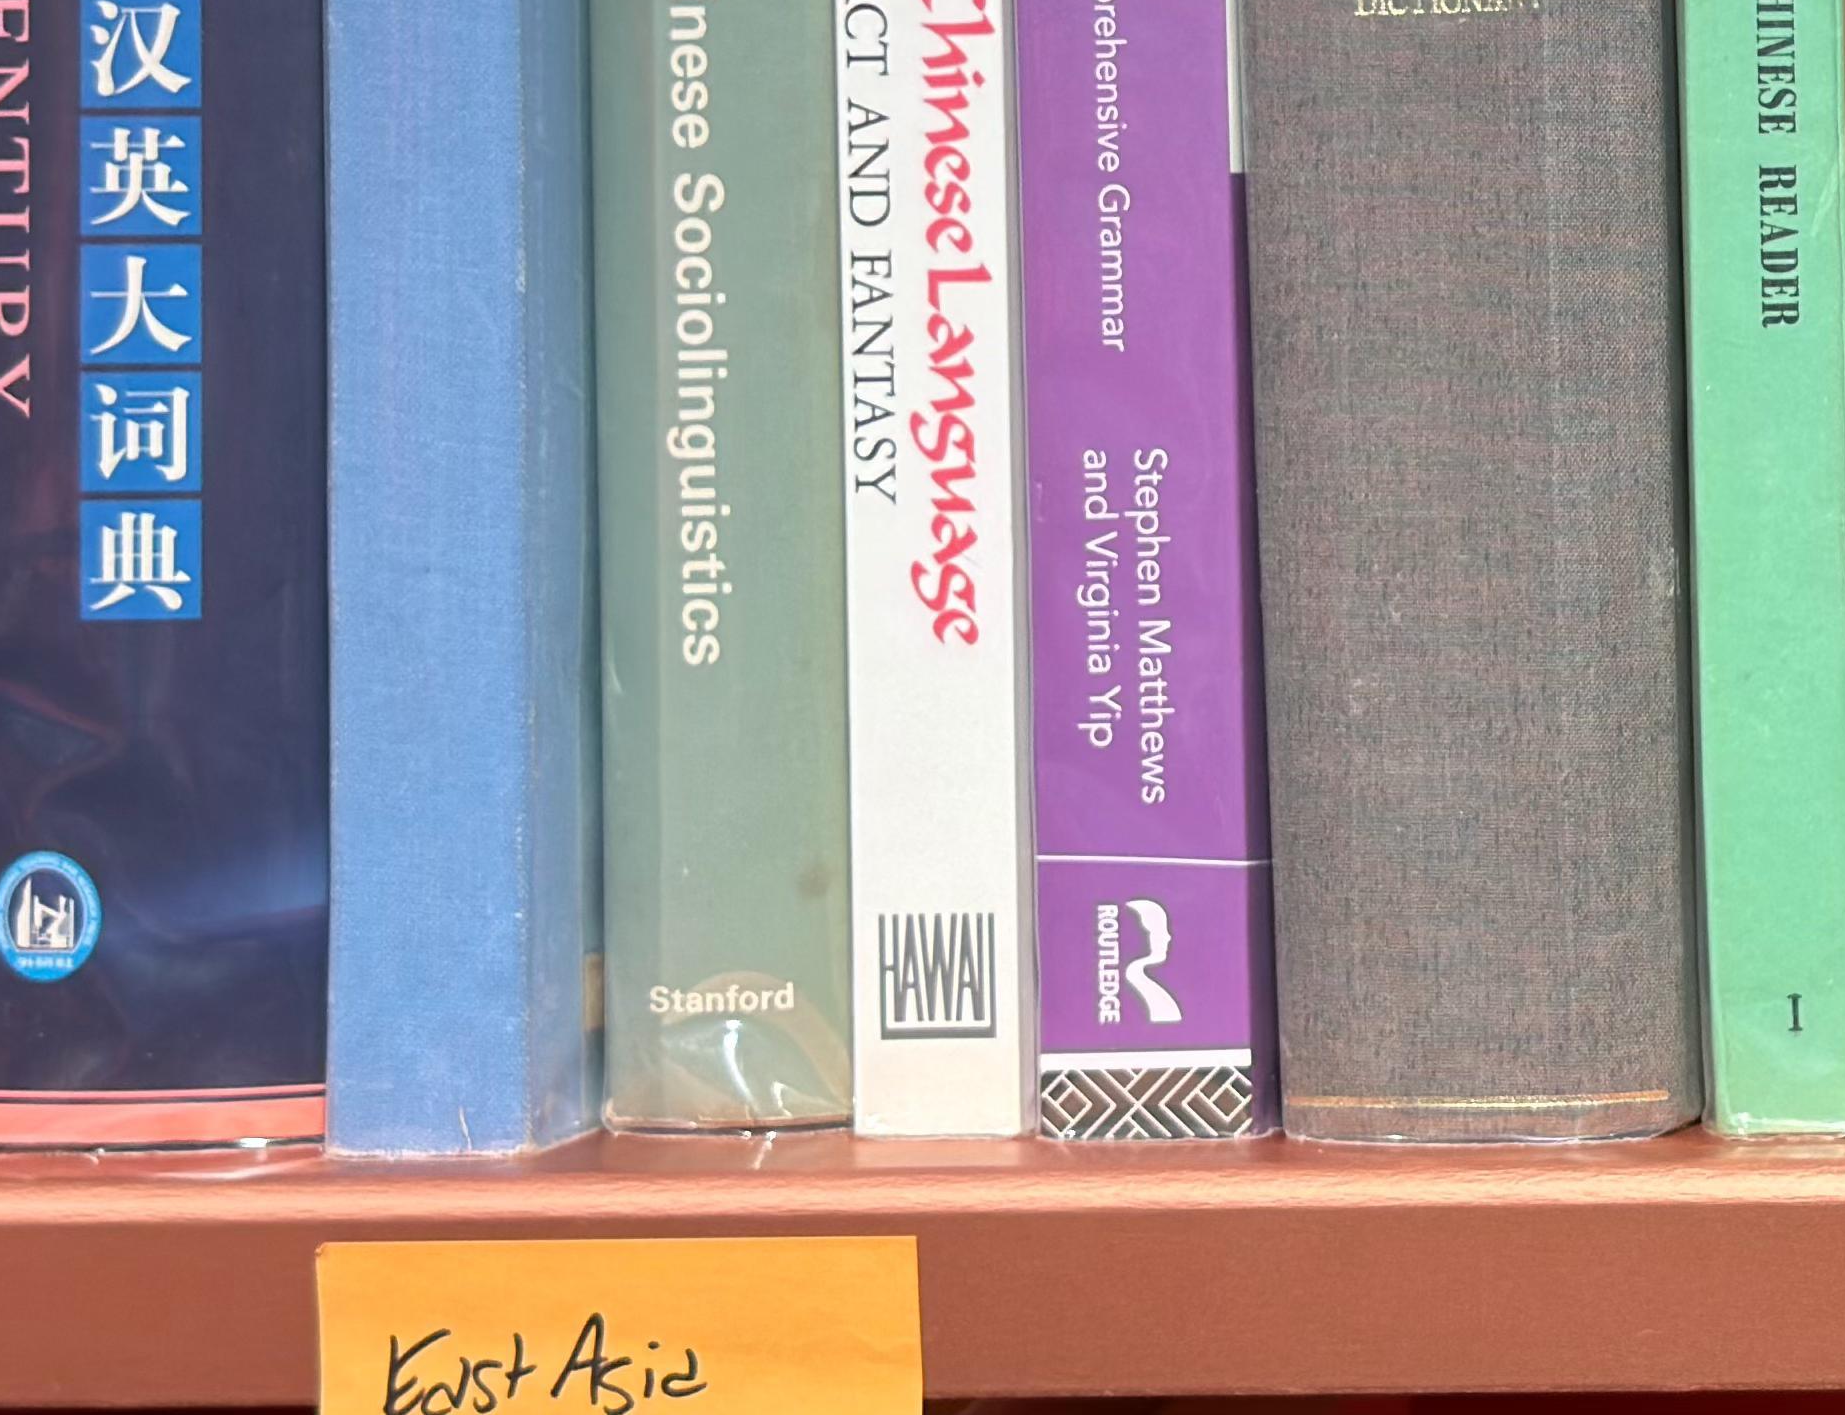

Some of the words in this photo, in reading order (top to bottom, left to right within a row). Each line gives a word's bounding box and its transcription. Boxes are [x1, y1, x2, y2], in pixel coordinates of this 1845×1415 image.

[846, 97, 892, 229] AND
[1098, 183, 1132, 353] Grammar
[1758, 164, 1801, 329] READER
[665, 172, 734, 667] Sociolinguistics
[849, 250, 897, 505] FANTASY
[908, 262, 993, 646] Language
[1081, 449, 1120, 521] and
[1123, 446, 1172, 607] Stephen
[1076, 530, 1122, 675] Virginia
[1077, 685, 1123, 748] Yip
[1138, 619, 1176, 805] Matthews
[648, 982, 796, 1014] Stanford
[1096, 904, 1122, 1025] ROUTLEDGE
[382, 1328, 537, 1415] East
[549, 1311, 709, 1415] Asia
